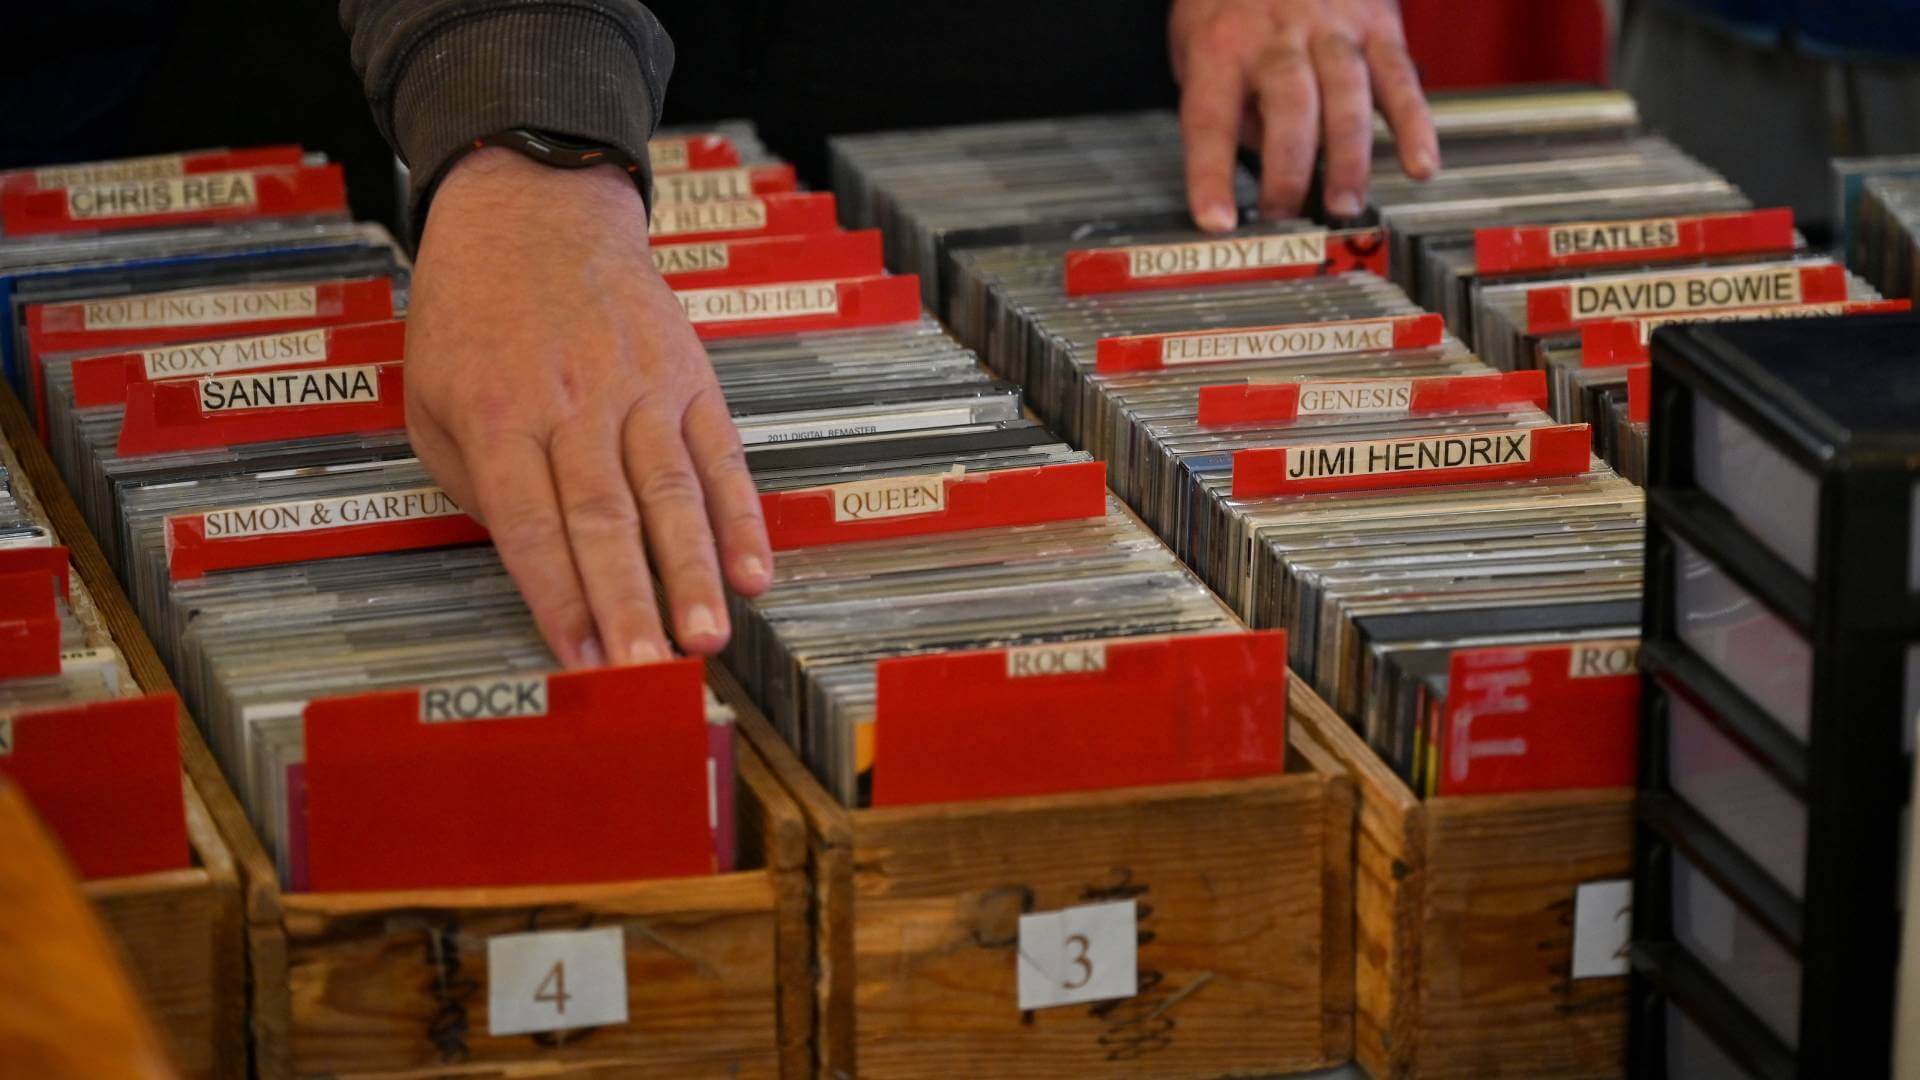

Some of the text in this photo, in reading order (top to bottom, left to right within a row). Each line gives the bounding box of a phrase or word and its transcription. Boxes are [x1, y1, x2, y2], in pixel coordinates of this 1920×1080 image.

[71, 173, 250, 217] CHRIS REA
[1132, 236, 1322, 275] BOB DYLAN
[1553, 223, 1675, 255] BEATLES
[88, 287, 314, 324] ROLLING STONES
[705, 286, 836, 315] OLDFIELD
[1577, 272, 1792, 314] DAVID BOWIE
[151, 333, 320, 372] ROXY MUSIC
[1165, 327, 1390, 361] FLEETWOOD MAC
[202, 370, 375, 410] SANTANA
[1300, 386, 1410, 412] GENESIS
[767, 425, 877, 443] 2011 DIGITAL REMASTER
[1289, 433, 1527, 478] JIMI HENDRIX
[207, 490, 460, 537] SIMON & GARFUN
[842, 484, 940, 518] QUEEN
[1012, 646, 1101, 675] ROCK
[1581, 647, 1638, 673] RO
[424, 681, 541, 721] ROCK
[1062, 933, 1093, 989] 3
[533, 960, 572, 1015] 4
